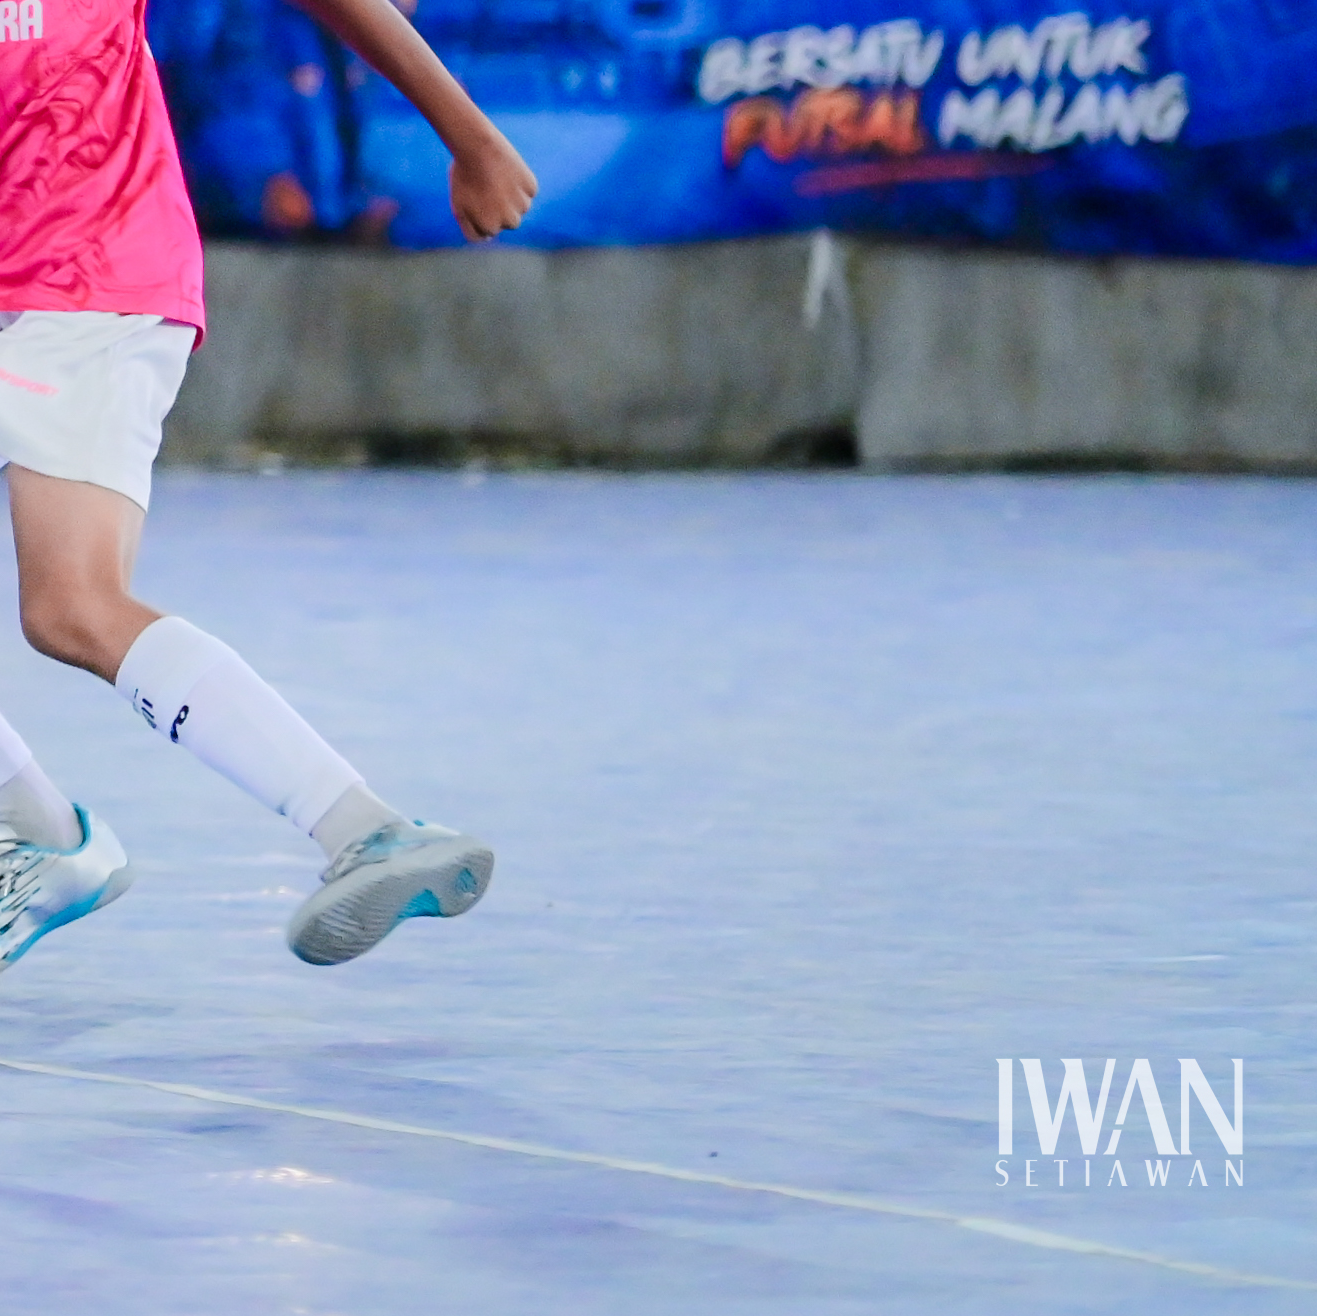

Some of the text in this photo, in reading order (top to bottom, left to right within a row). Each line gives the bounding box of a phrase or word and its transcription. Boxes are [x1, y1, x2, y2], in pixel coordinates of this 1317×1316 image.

[697, 11, 1153, 108] BERSATU UNTUK
[722, 73, 1190, 168] FUTSAL MALANG
